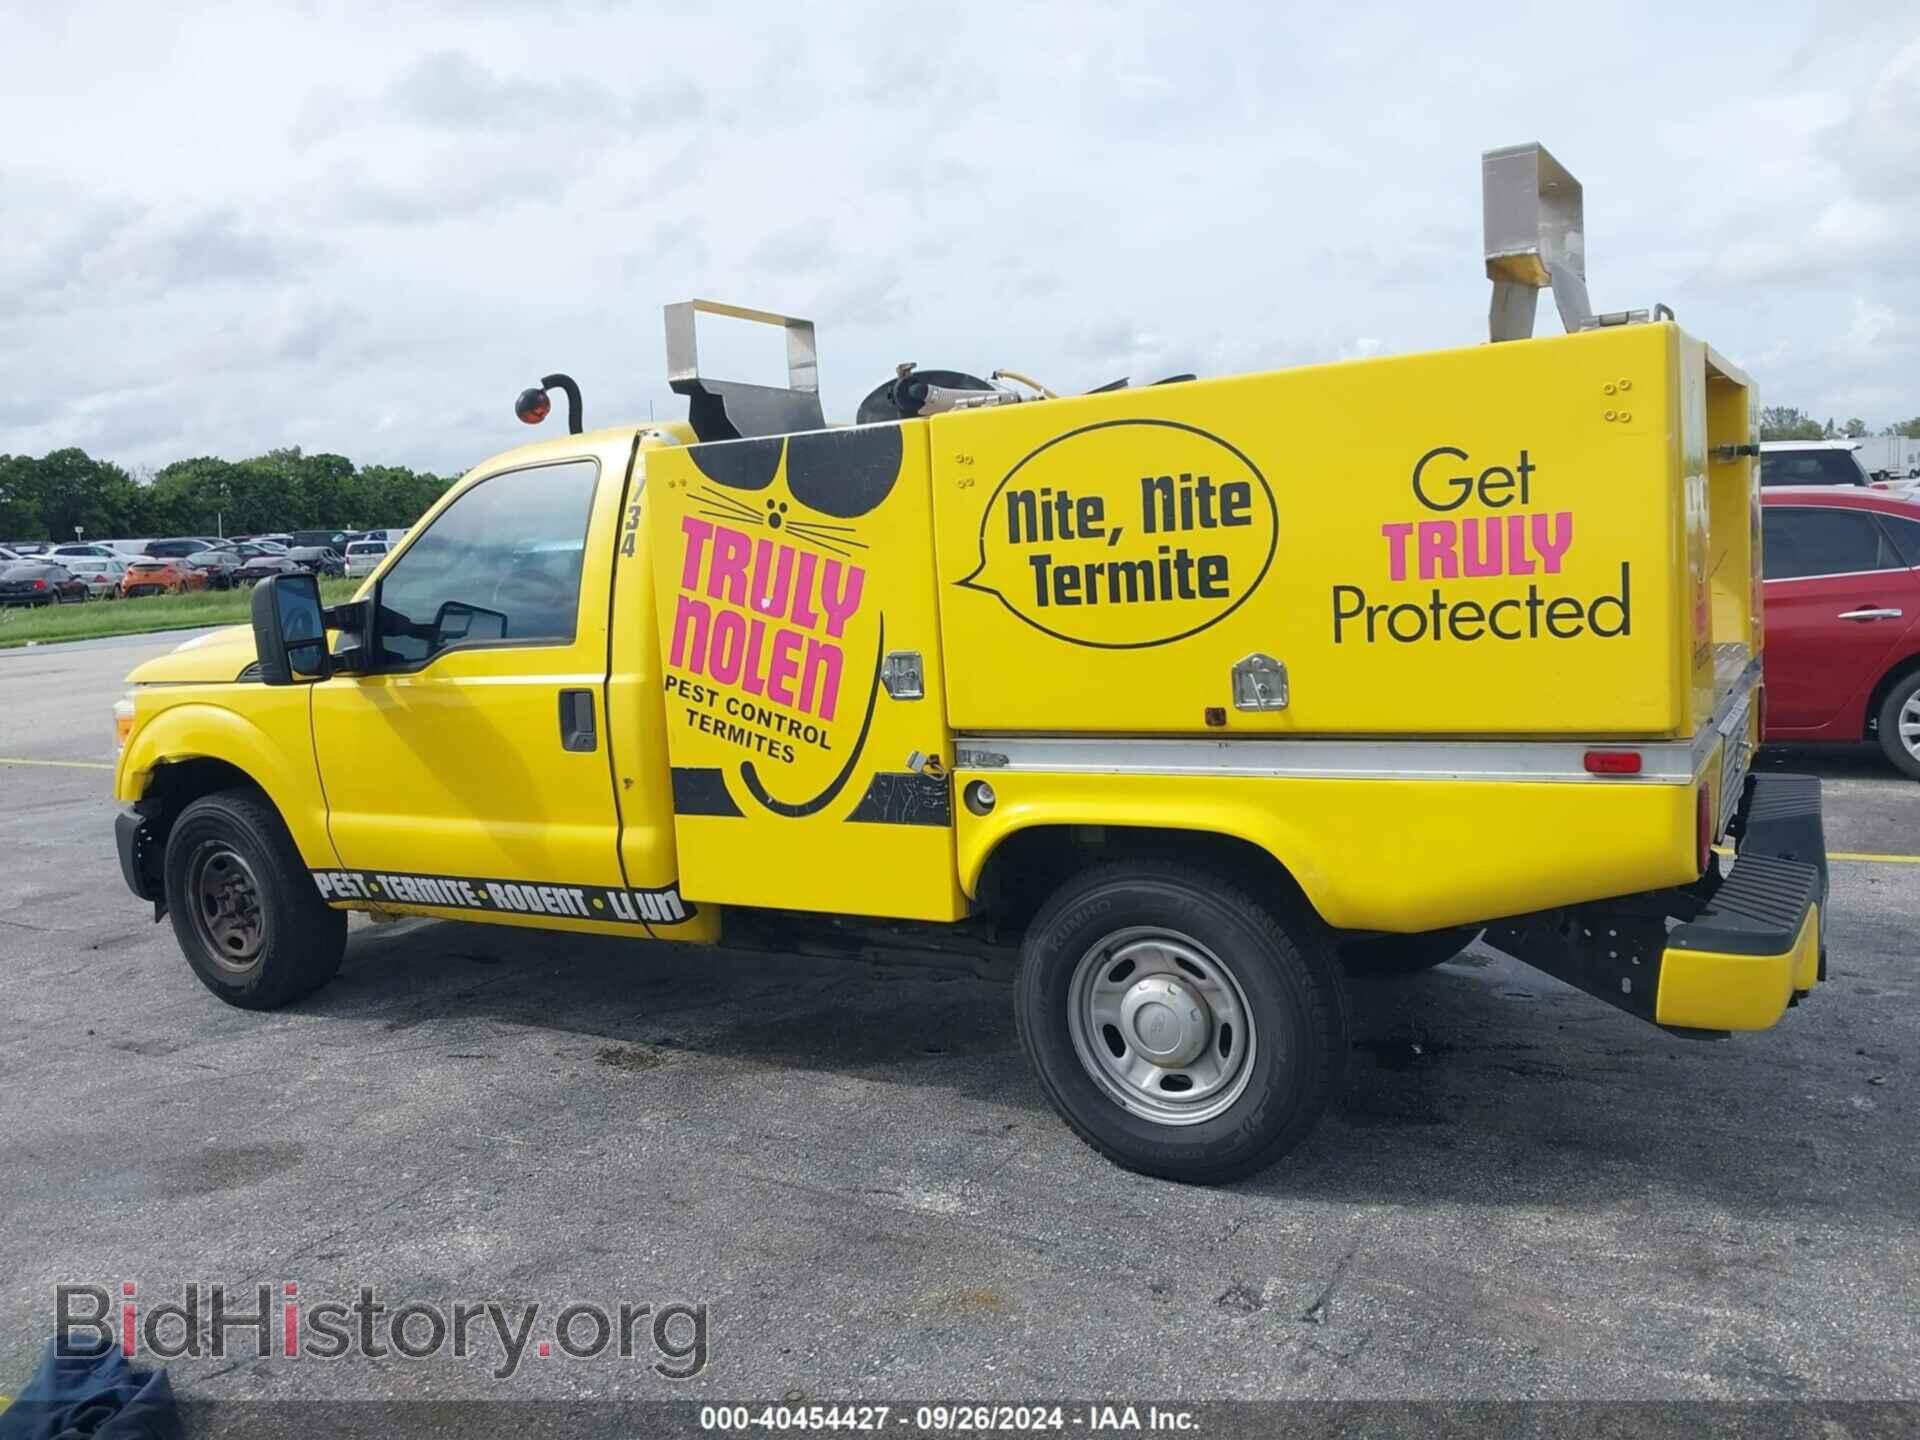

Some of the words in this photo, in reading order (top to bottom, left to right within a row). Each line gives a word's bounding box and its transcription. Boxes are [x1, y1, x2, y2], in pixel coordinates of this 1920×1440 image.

[1006, 487, 1123, 547] Nite,
[1141, 473, 1252, 534] Nite
[1412, 446, 1536, 512] Get
[681, 516, 866, 638] TRULY
[1029, 545, 1230, 607] Termite
[1381, 511, 1573, 580] TRULY
[1332, 561, 1631, 644] Protected
[669, 595, 844, 722] NOLEN
[664, 674, 719, 708] PEST
[726, 697, 833, 751] CONTROL
[686, 708, 796, 765] TERMITES
[312, 872, 372, 899] PEST
[375, 875, 482, 907] TERMITE
[486, 882, 591, 917] RODENT
